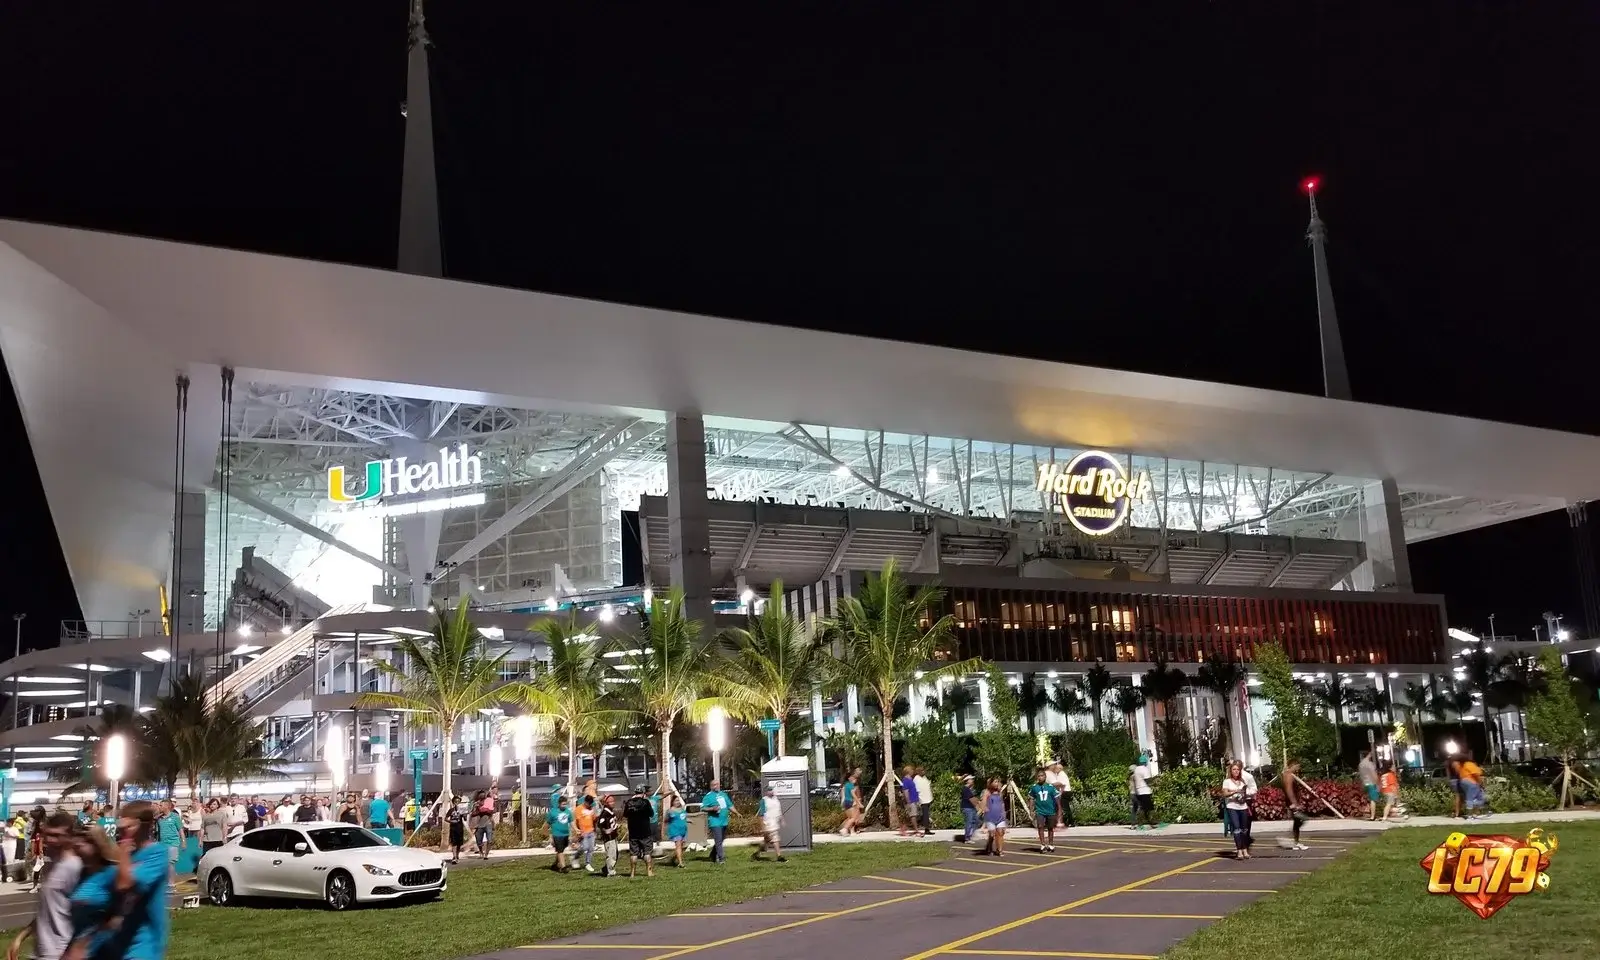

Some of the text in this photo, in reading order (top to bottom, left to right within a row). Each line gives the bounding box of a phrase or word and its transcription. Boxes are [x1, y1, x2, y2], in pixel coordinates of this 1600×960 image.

[1036, 463, 1151, 504] Hard Rock
[1073, 506, 1116, 519] STADIUM
[1038, 790, 1049, 801] 17
[104, 823, 117, 837] 23
